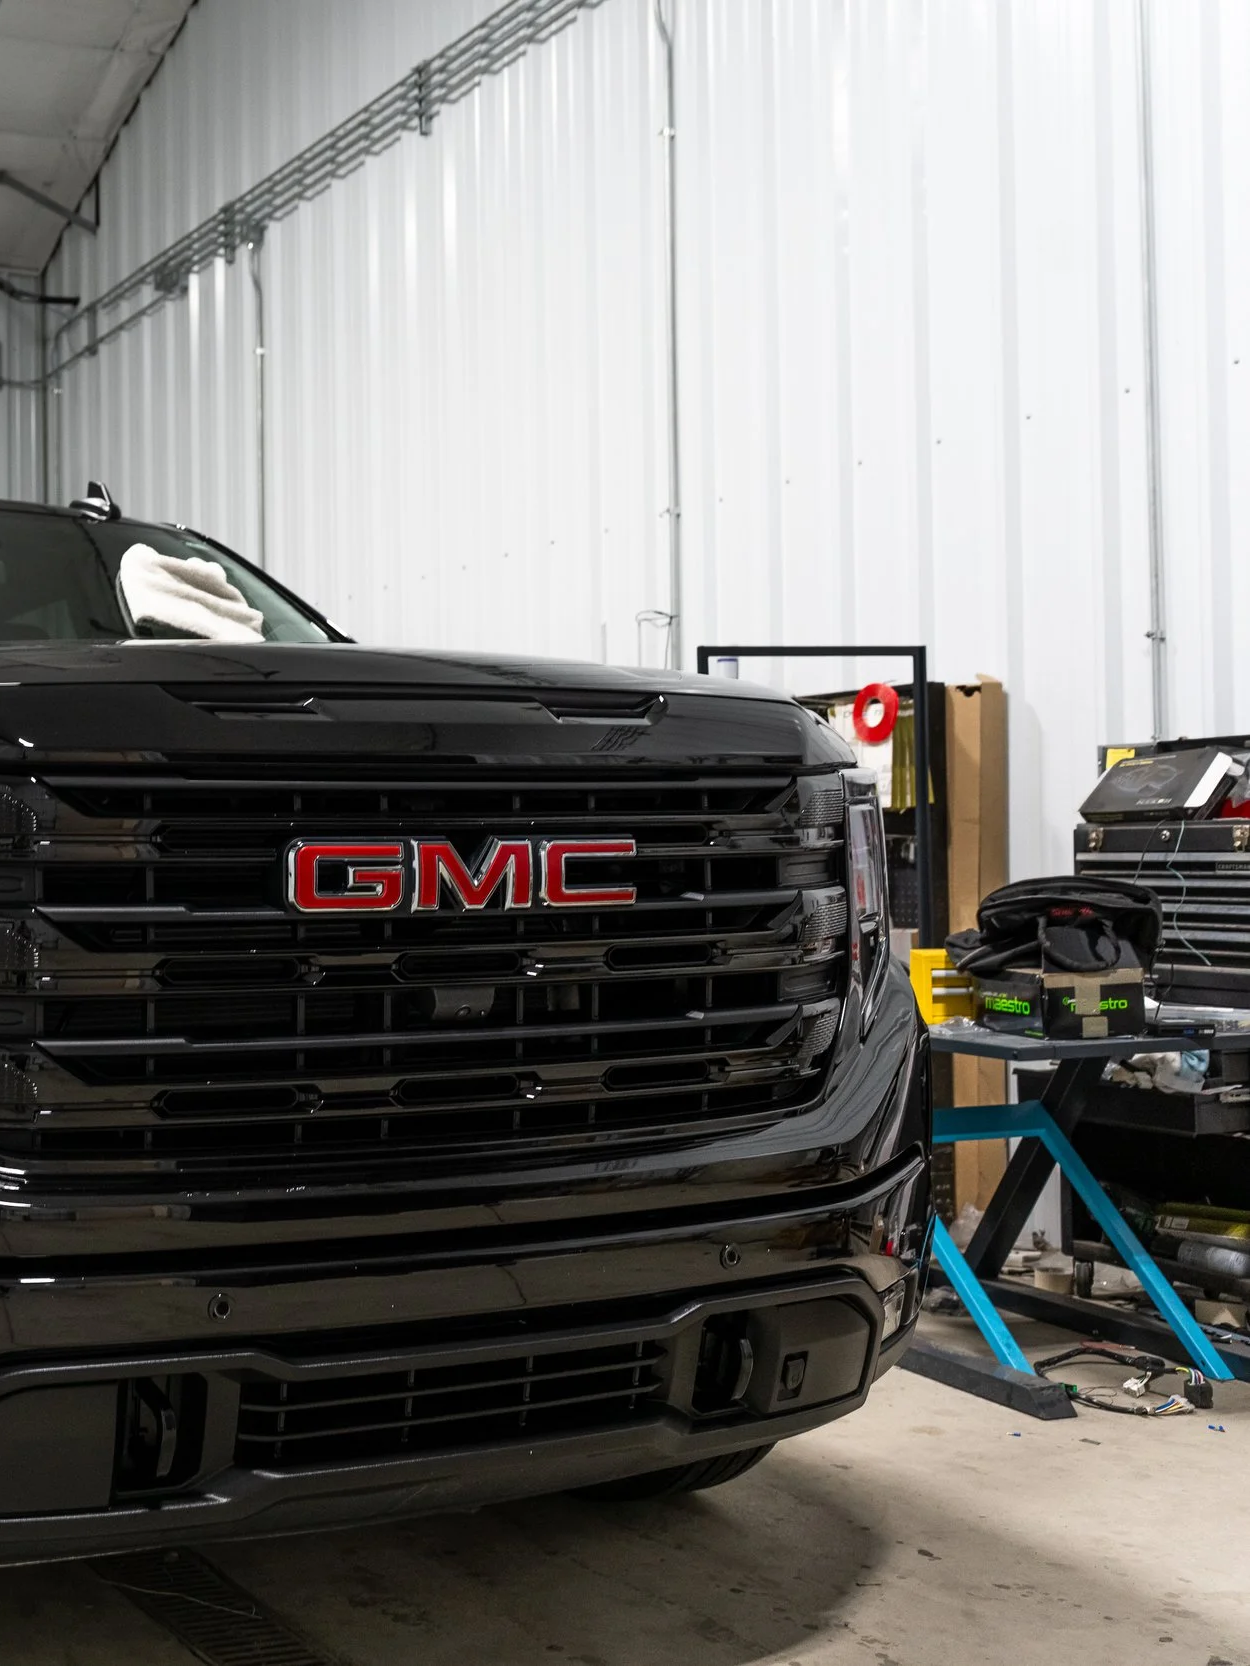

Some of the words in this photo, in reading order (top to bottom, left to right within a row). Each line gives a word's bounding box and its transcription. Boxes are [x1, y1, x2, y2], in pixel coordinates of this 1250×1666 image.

[288, 836, 637, 914] GMC
[985, 996, 1031, 1015] maestro
[1070, 997, 1128, 1013] stro
